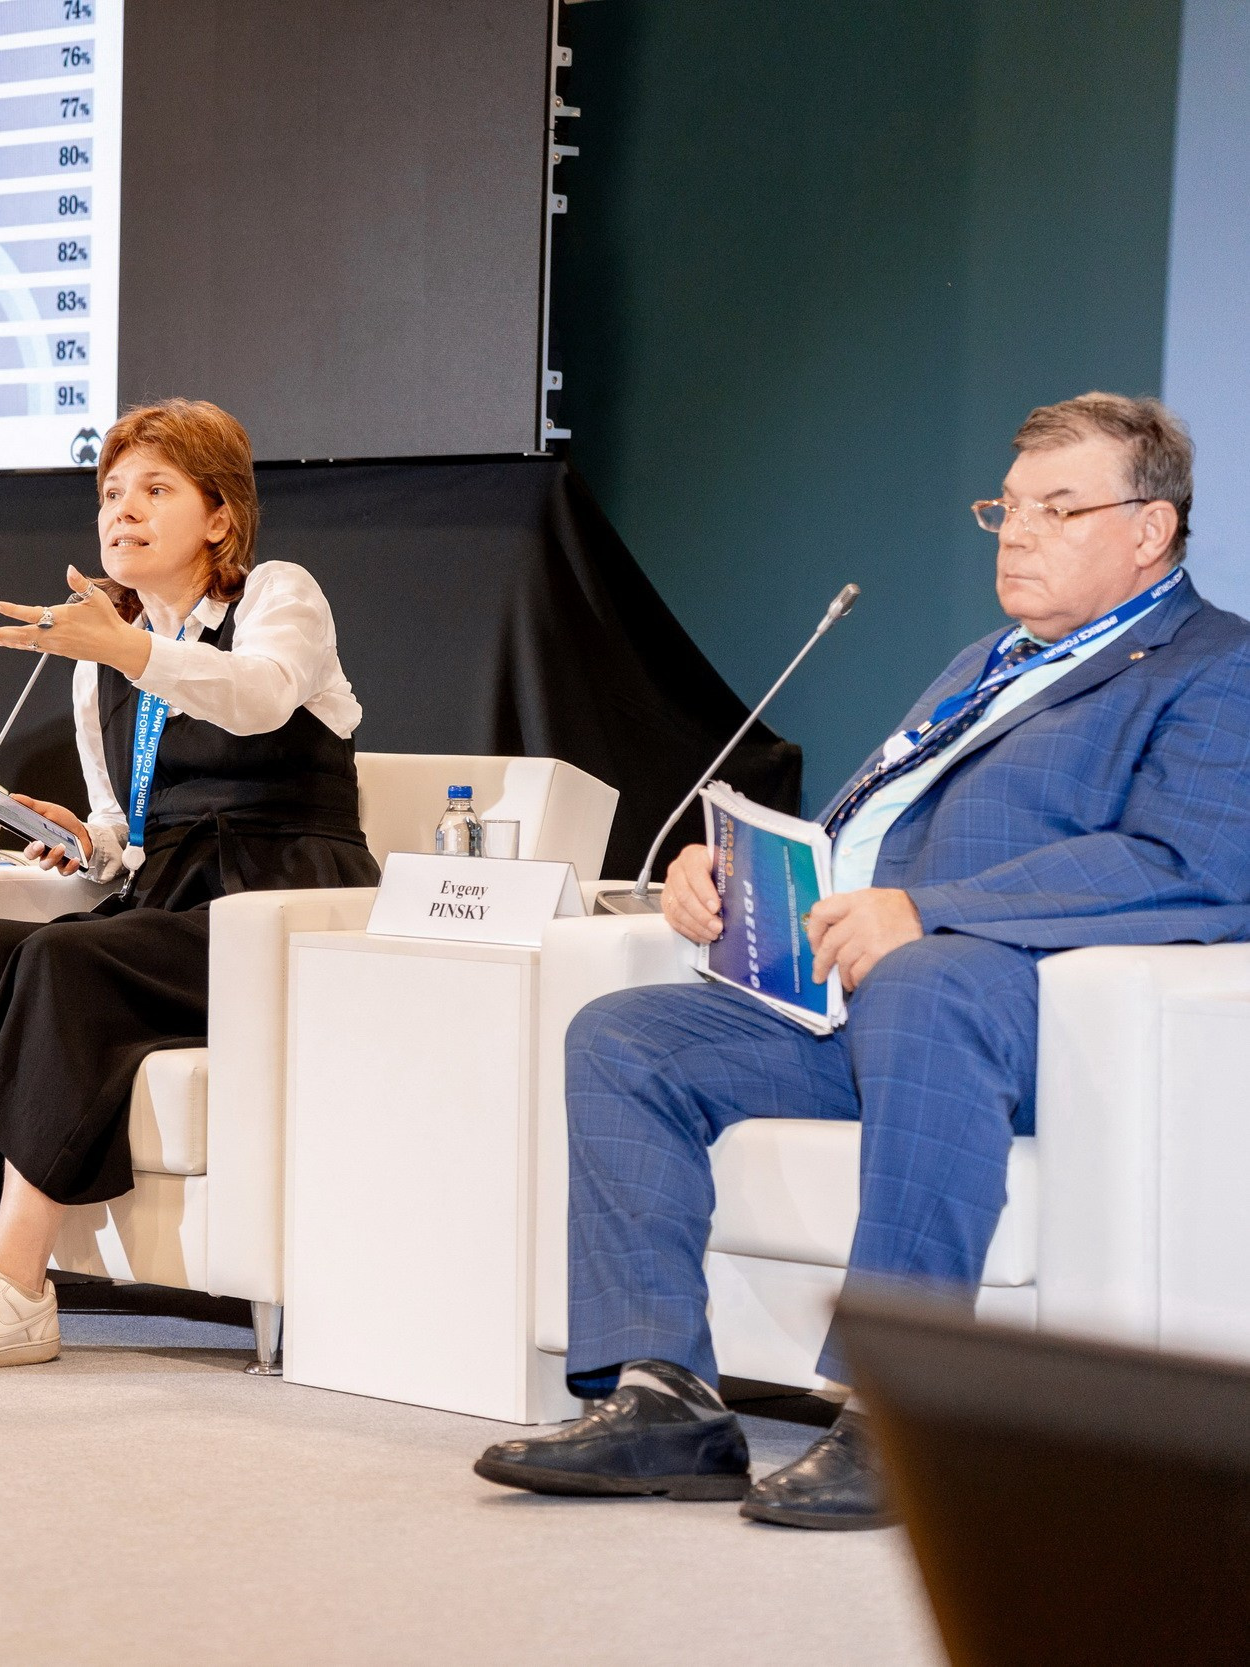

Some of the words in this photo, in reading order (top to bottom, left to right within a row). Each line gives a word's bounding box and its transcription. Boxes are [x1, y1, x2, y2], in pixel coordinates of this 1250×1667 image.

[63, 0, 92, 20] 74%
[61, 46, 91, 68] 76%
[60, 97, 90, 118] 77%
[59, 145, 89, 166] 80%
[58, 195, 88, 216] 80%
[58, 241, 88, 262] 82%
[57, 290, 87, 312] 83%
[56, 340, 86, 360] 87%
[58, 386, 86, 406] 91%
[142, 691, 152, 712] RICS
[137, 713, 149, 750] FORUM
[134, 776, 149, 817] IMBRICS
[142, 737, 156, 774] FORUM
[440, 880, 489, 900] Evgeny
[428, 902, 490, 921] PINSKY
